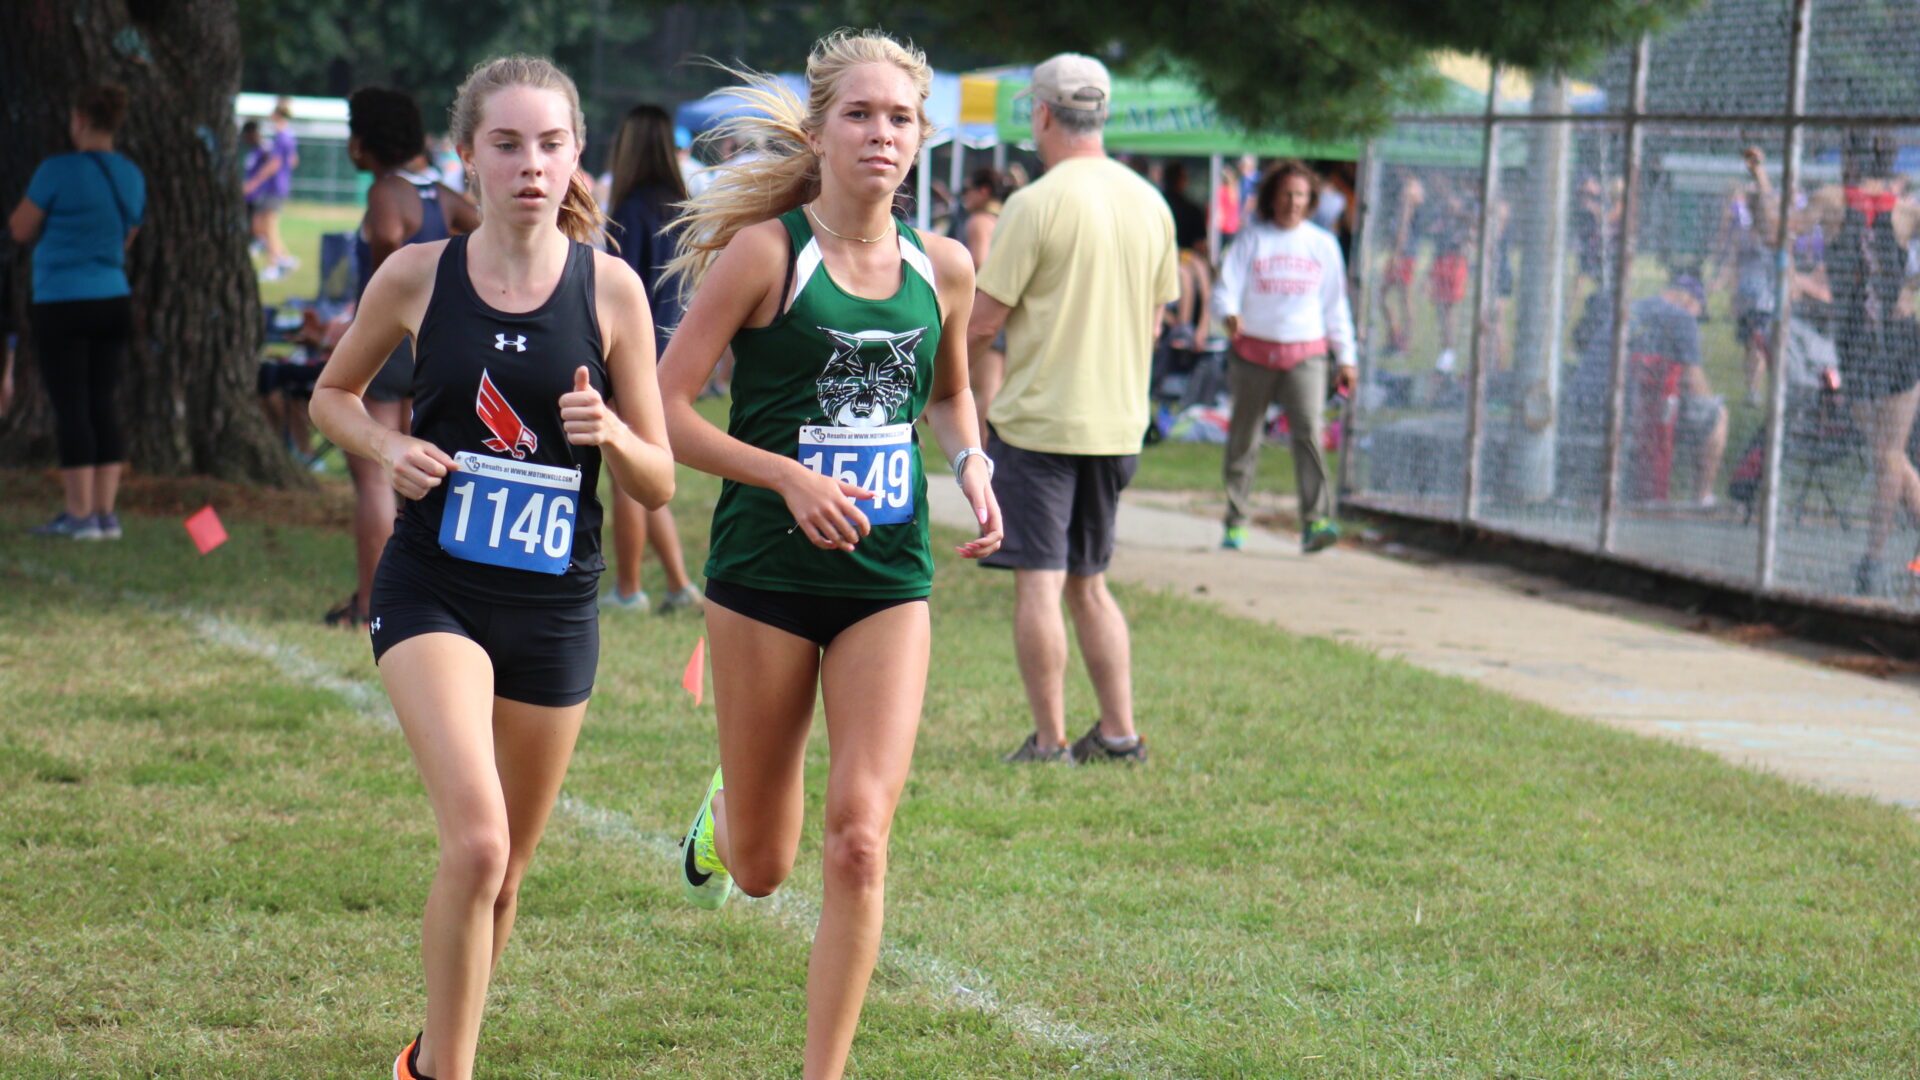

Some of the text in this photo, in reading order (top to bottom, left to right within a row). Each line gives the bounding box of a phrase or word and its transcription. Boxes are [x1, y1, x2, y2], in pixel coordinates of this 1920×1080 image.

[827, 432, 847, 440] Results
[481, 462, 502, 473] Results
[803, 449, 910, 510] 1549
[453, 481, 574, 558] 1146
